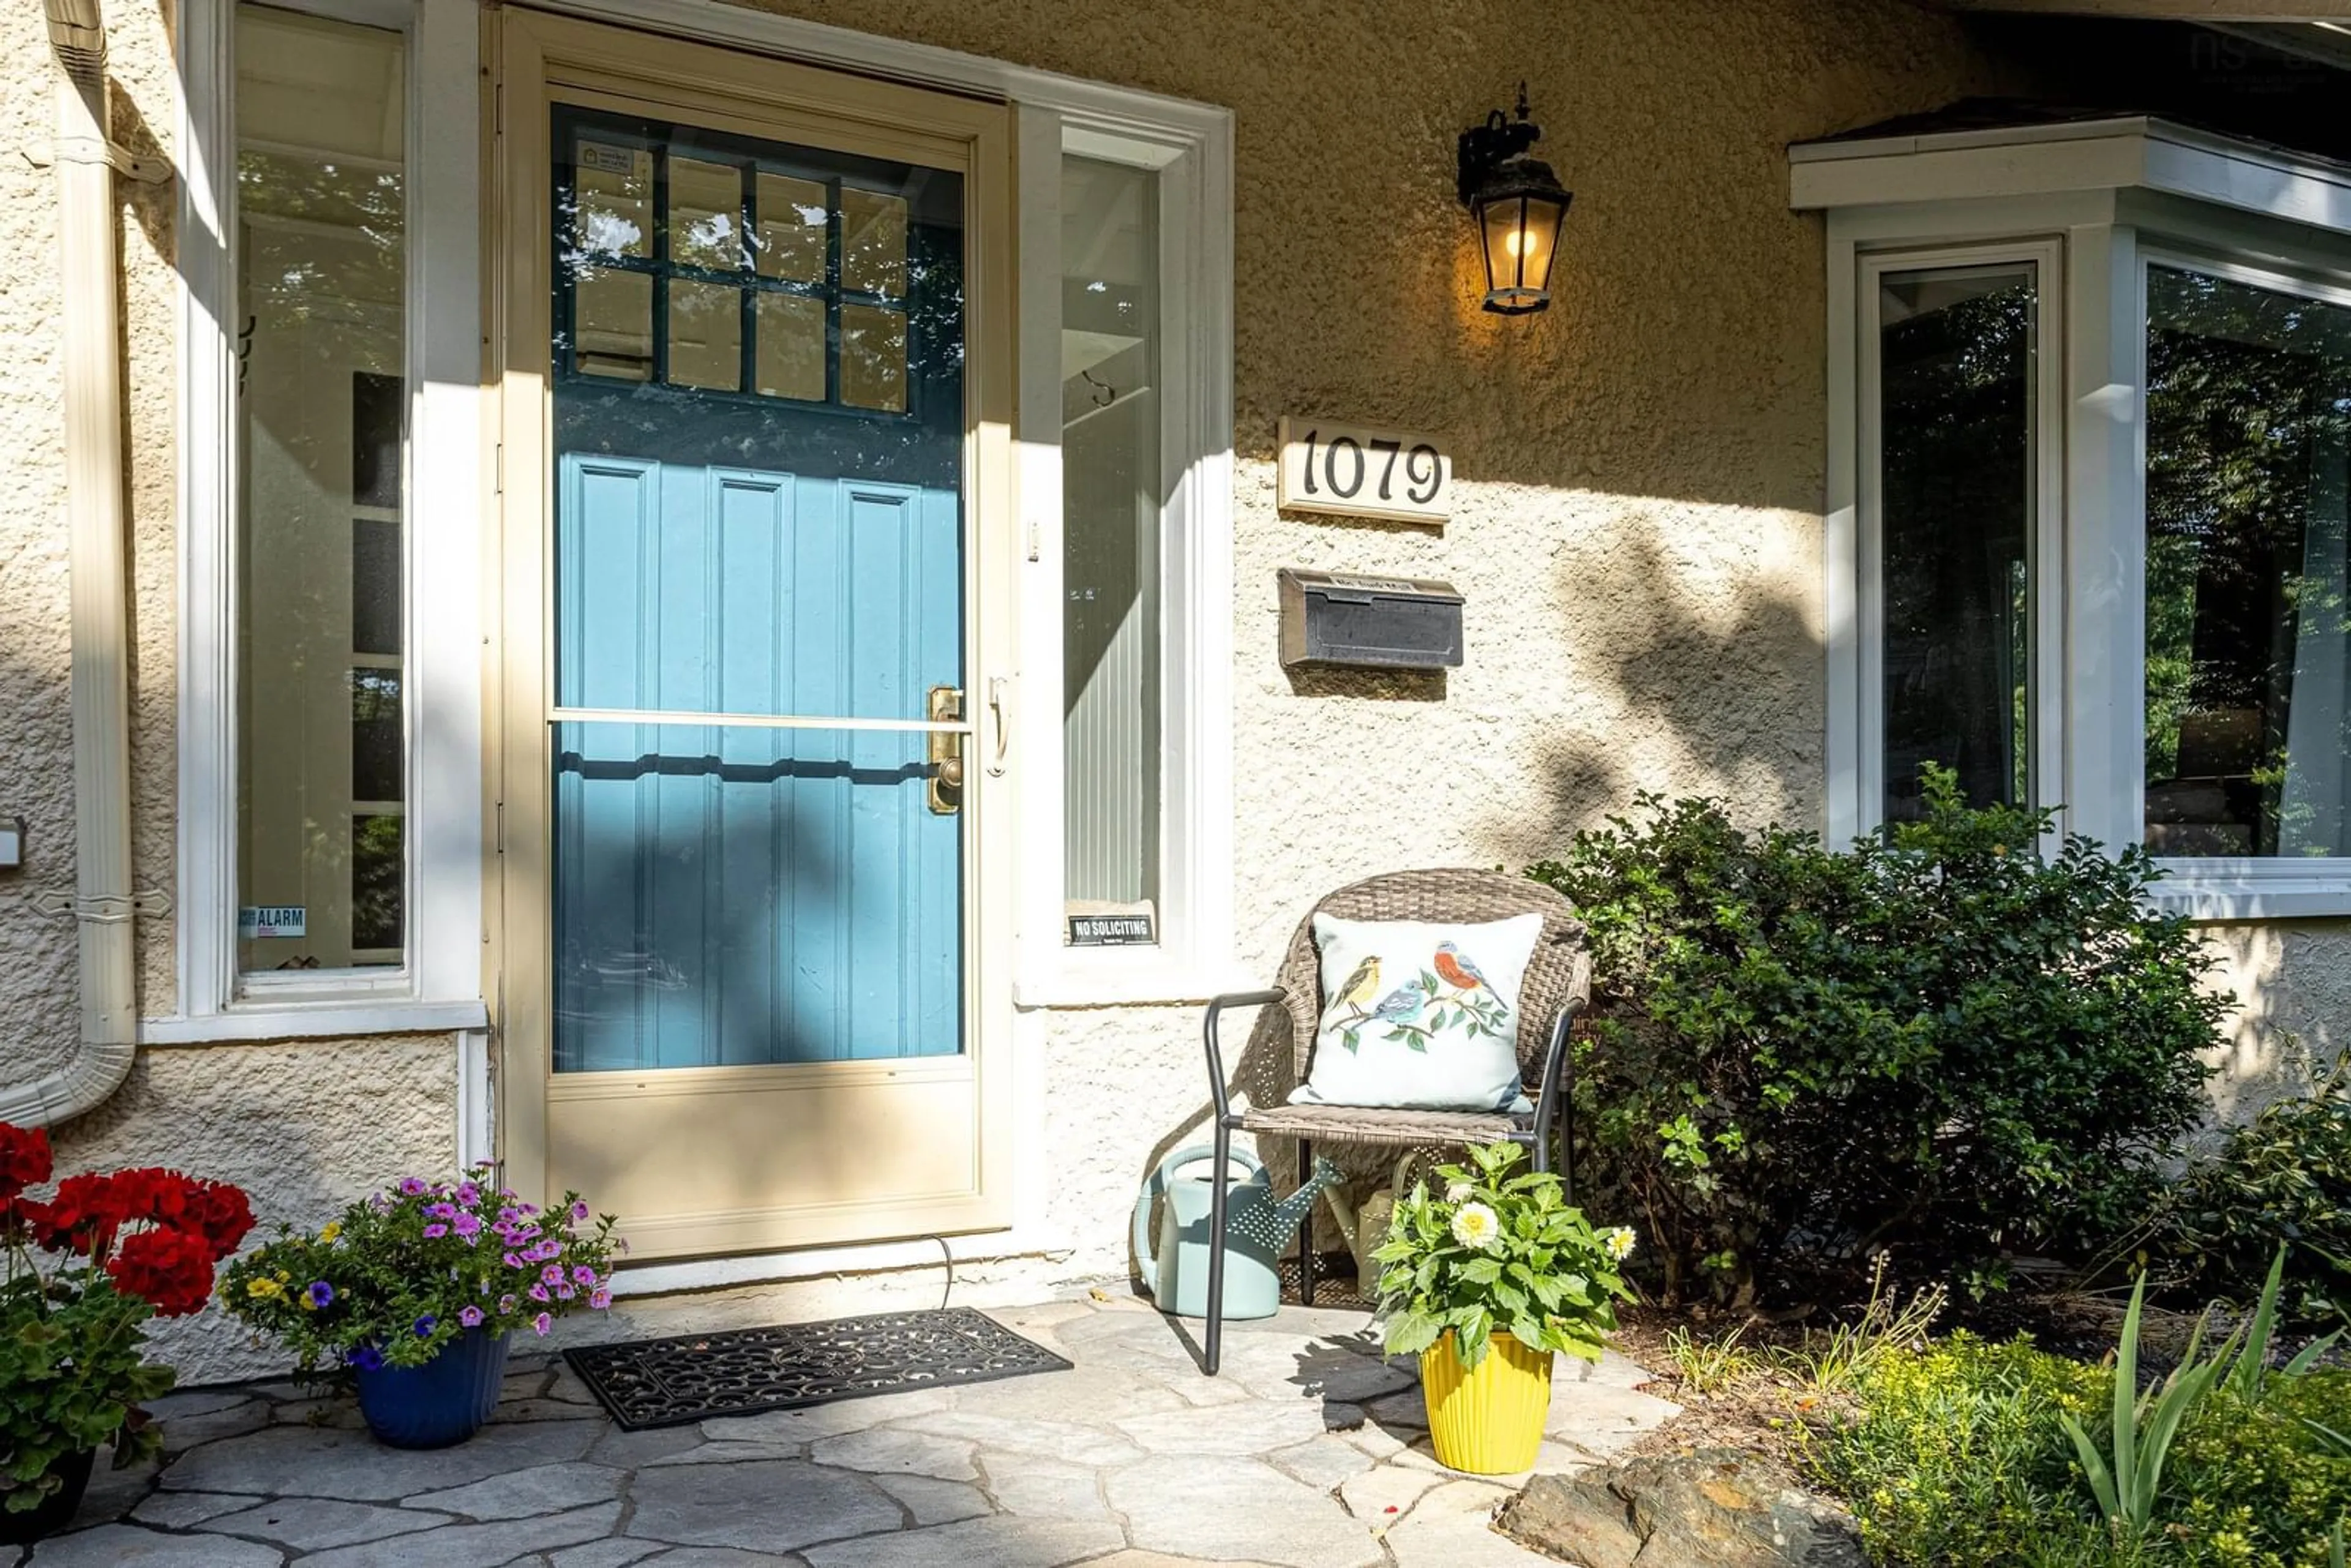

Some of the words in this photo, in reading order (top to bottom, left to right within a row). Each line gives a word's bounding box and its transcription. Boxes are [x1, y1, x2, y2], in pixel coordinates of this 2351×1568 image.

[1304, 429, 1442, 504] 1079
[258, 909, 303, 926] ALARM
[1075, 921, 1091, 937] NO
[1092, 920, 1148, 936] SOLICITING
